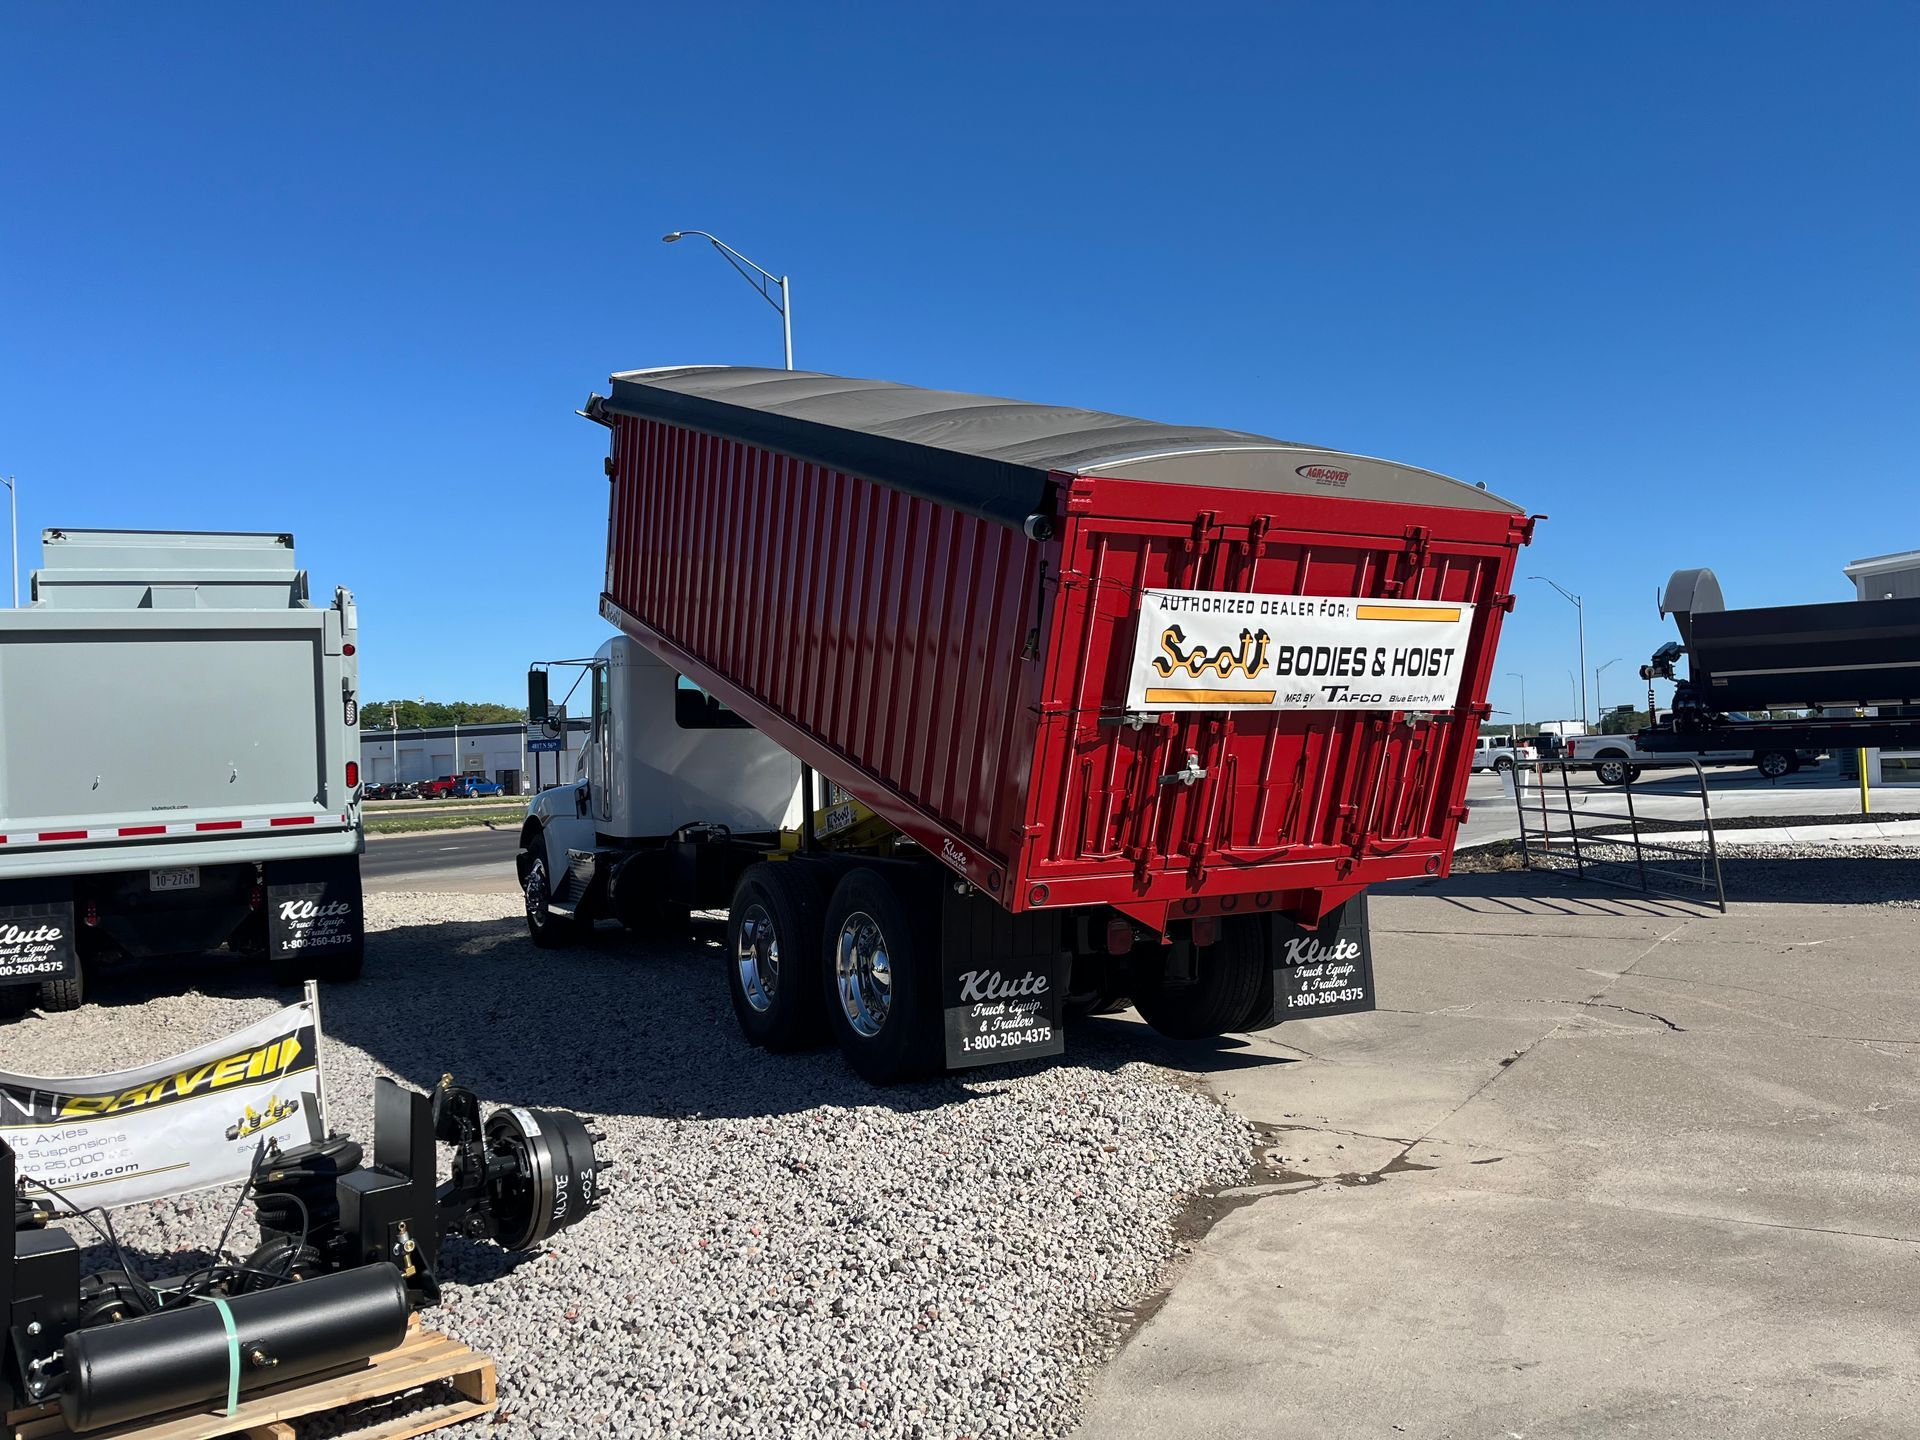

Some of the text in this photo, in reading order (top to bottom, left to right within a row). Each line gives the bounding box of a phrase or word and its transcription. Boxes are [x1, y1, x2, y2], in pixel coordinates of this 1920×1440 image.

[1306, 467, 1349, 481] AGRI-COVER
[1160, 596, 1349, 618] AUTHORIZED DEALER FOR:
[1152, 624, 1455, 679] Scott BODIES & HOIST
[1303, 693, 1316, 703] BY
[1389, 695, 1406, 703] Blue
[1407, 695, 1431, 704] Earth,
[943, 838, 967, 865] Klute
[156, 873, 195, 887] 10-276M
[279, 900, 351, 920] Klute
[288, 917, 345, 930] Truck Equip.
[303, 927, 338, 937] Trailers
[23, 943, 56, 954] Equip.
[281, 934, 352, 950] 1-800-260-4375
[1284, 937, 1360, 965] Klute
[7, 953, 47, 964] Trailers
[1294, 962, 1356, 978] Truck Equip.
[958, 969, 1050, 1001] Klute
[1301, 977, 1348, 991] & Trailers
[1287, 988, 1364, 1008] 1-800-260-4375
[970, 999, 1043, 1018] Truck Equip.
[979, 1015, 1034, 1032] & Trailers
[962, 1026, 1051, 1051] 1-800-260-4375
[8, 1128, 88, 1147] ift Axles
[28, 1134, 127, 1160] Suspensions
[237, 1141, 263, 1154] SINC
[23, 1163, 41, 1173] to
[44, 1151, 105, 1171] 25,000
[553, 1174, 568, 1220] KLUTE
